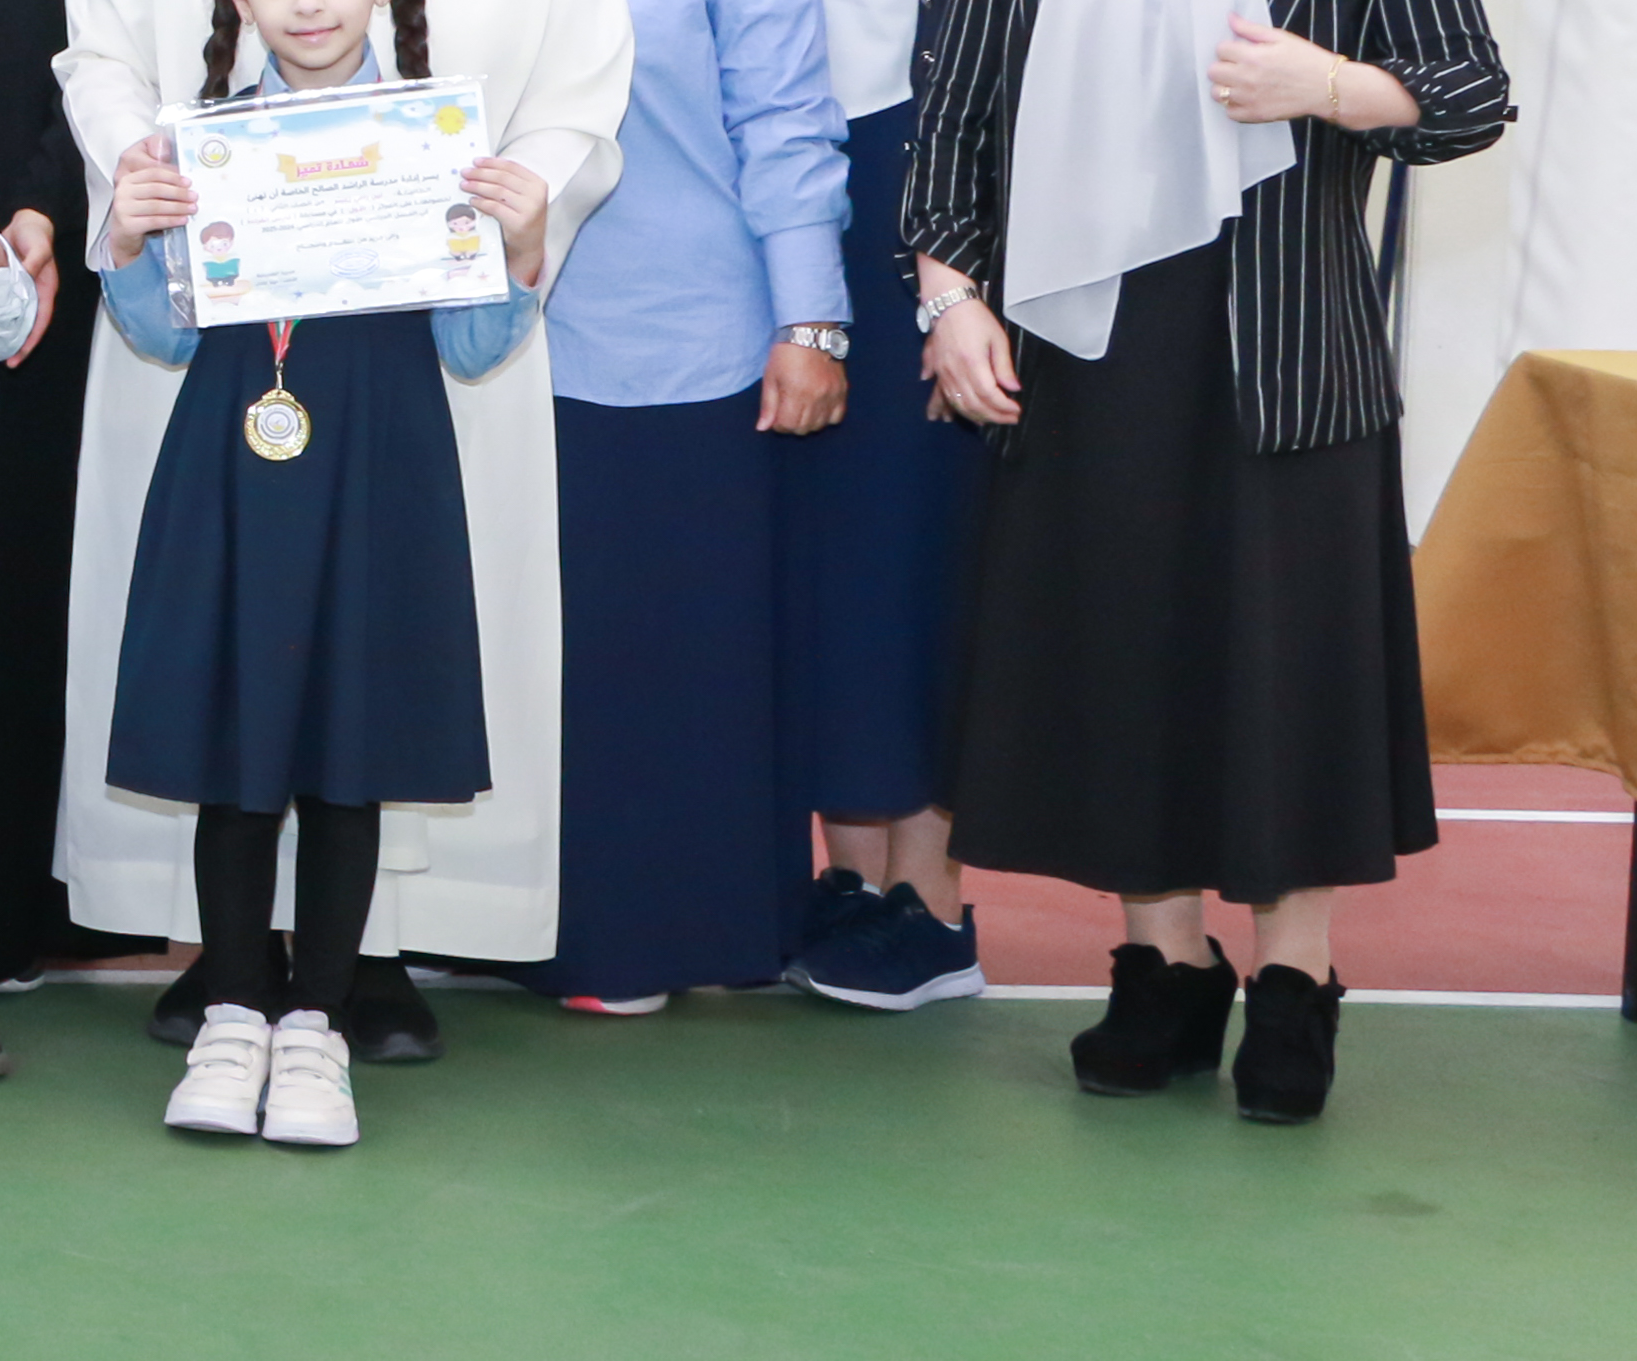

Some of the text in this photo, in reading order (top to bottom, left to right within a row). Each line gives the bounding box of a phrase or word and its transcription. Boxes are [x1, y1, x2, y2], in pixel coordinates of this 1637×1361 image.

[295, 154, 369, 179] شهادة تميز
[281, 186, 309, 196] الخاصة
[312, 183, 338, 196] الصالح
[342, 180, 367, 190] الراشد
[268, 188, 279, 200] أن
